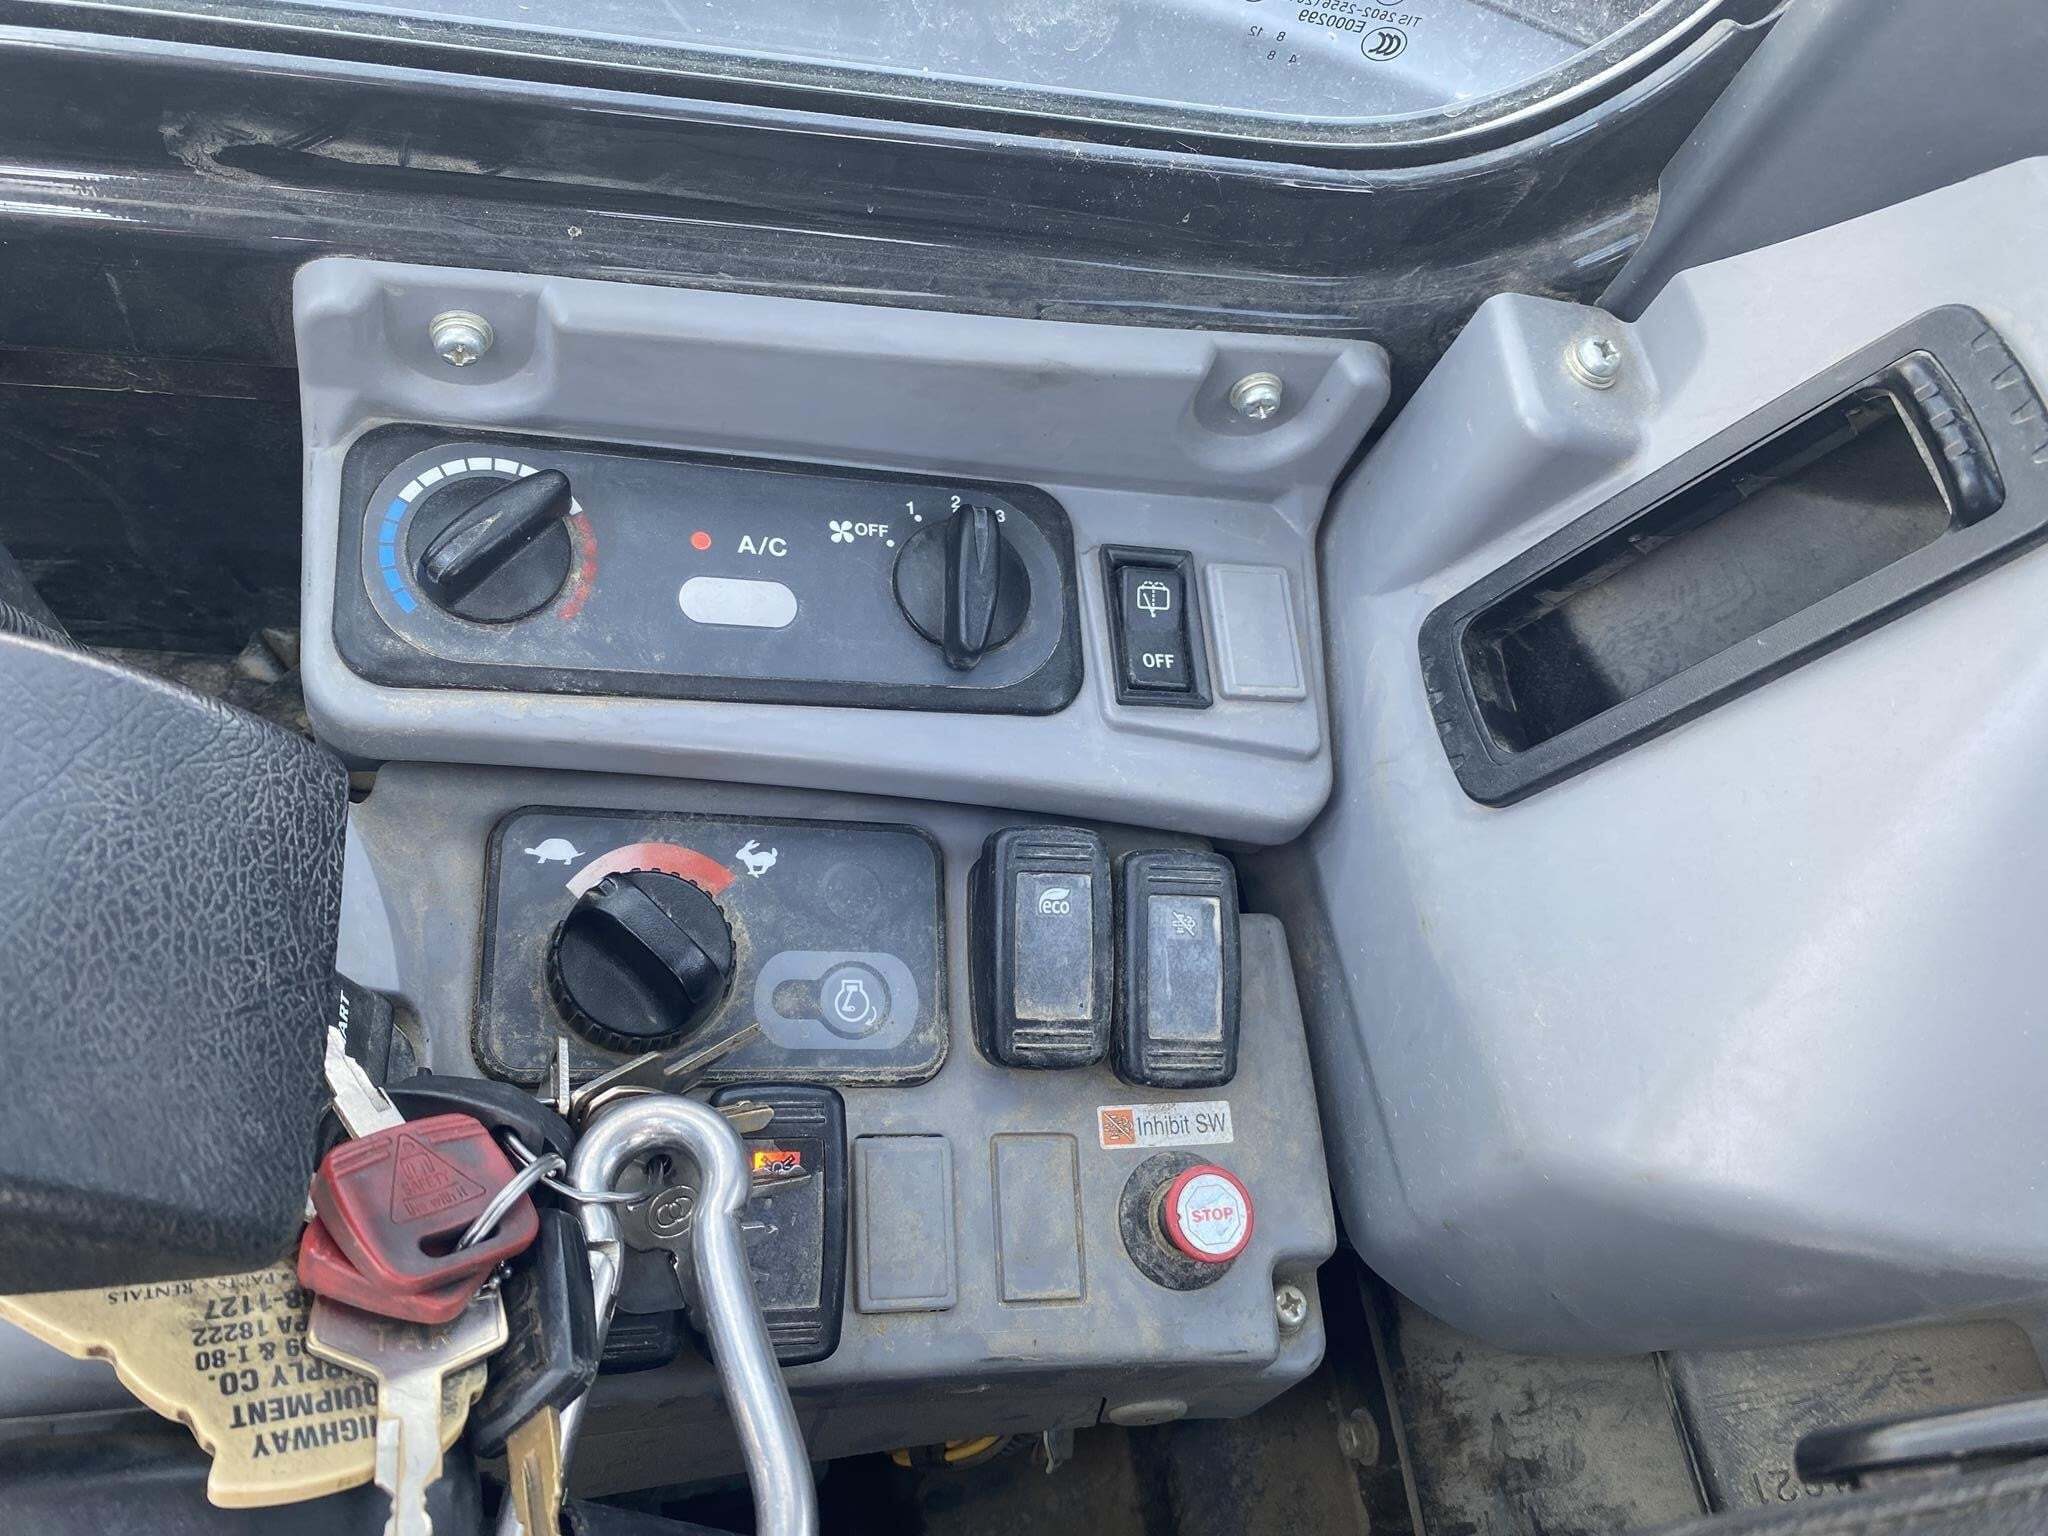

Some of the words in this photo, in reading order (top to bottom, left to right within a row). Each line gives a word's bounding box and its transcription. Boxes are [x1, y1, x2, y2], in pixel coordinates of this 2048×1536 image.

[905, 501, 916, 515] 1
[950, 495, 961, 508] 2
[995, 510, 1006, 523] 3
[854, 523, 889, 538] OFF
[738, 535, 788, 557] A/C
[1142, 653, 1174, 669] OFF
[1040, 899, 1071, 915] eco
[338, 989, 350, 1039] ART
[1137, 1115, 1190, 1137] Inhibit
[1196, 1112, 1226, 1133] SW
[1191, 1206, 1234, 1223] STOP
[108, 1282, 193, 1305] RENTALS
[192, 1320, 270, 1346] 18222
[277, 1315, 308, 1334] PA
[257, 1341, 276, 1361] &
[209, 1368, 259, 1396] CO.
[230, 1381, 377, 1428] QUIPMENT
